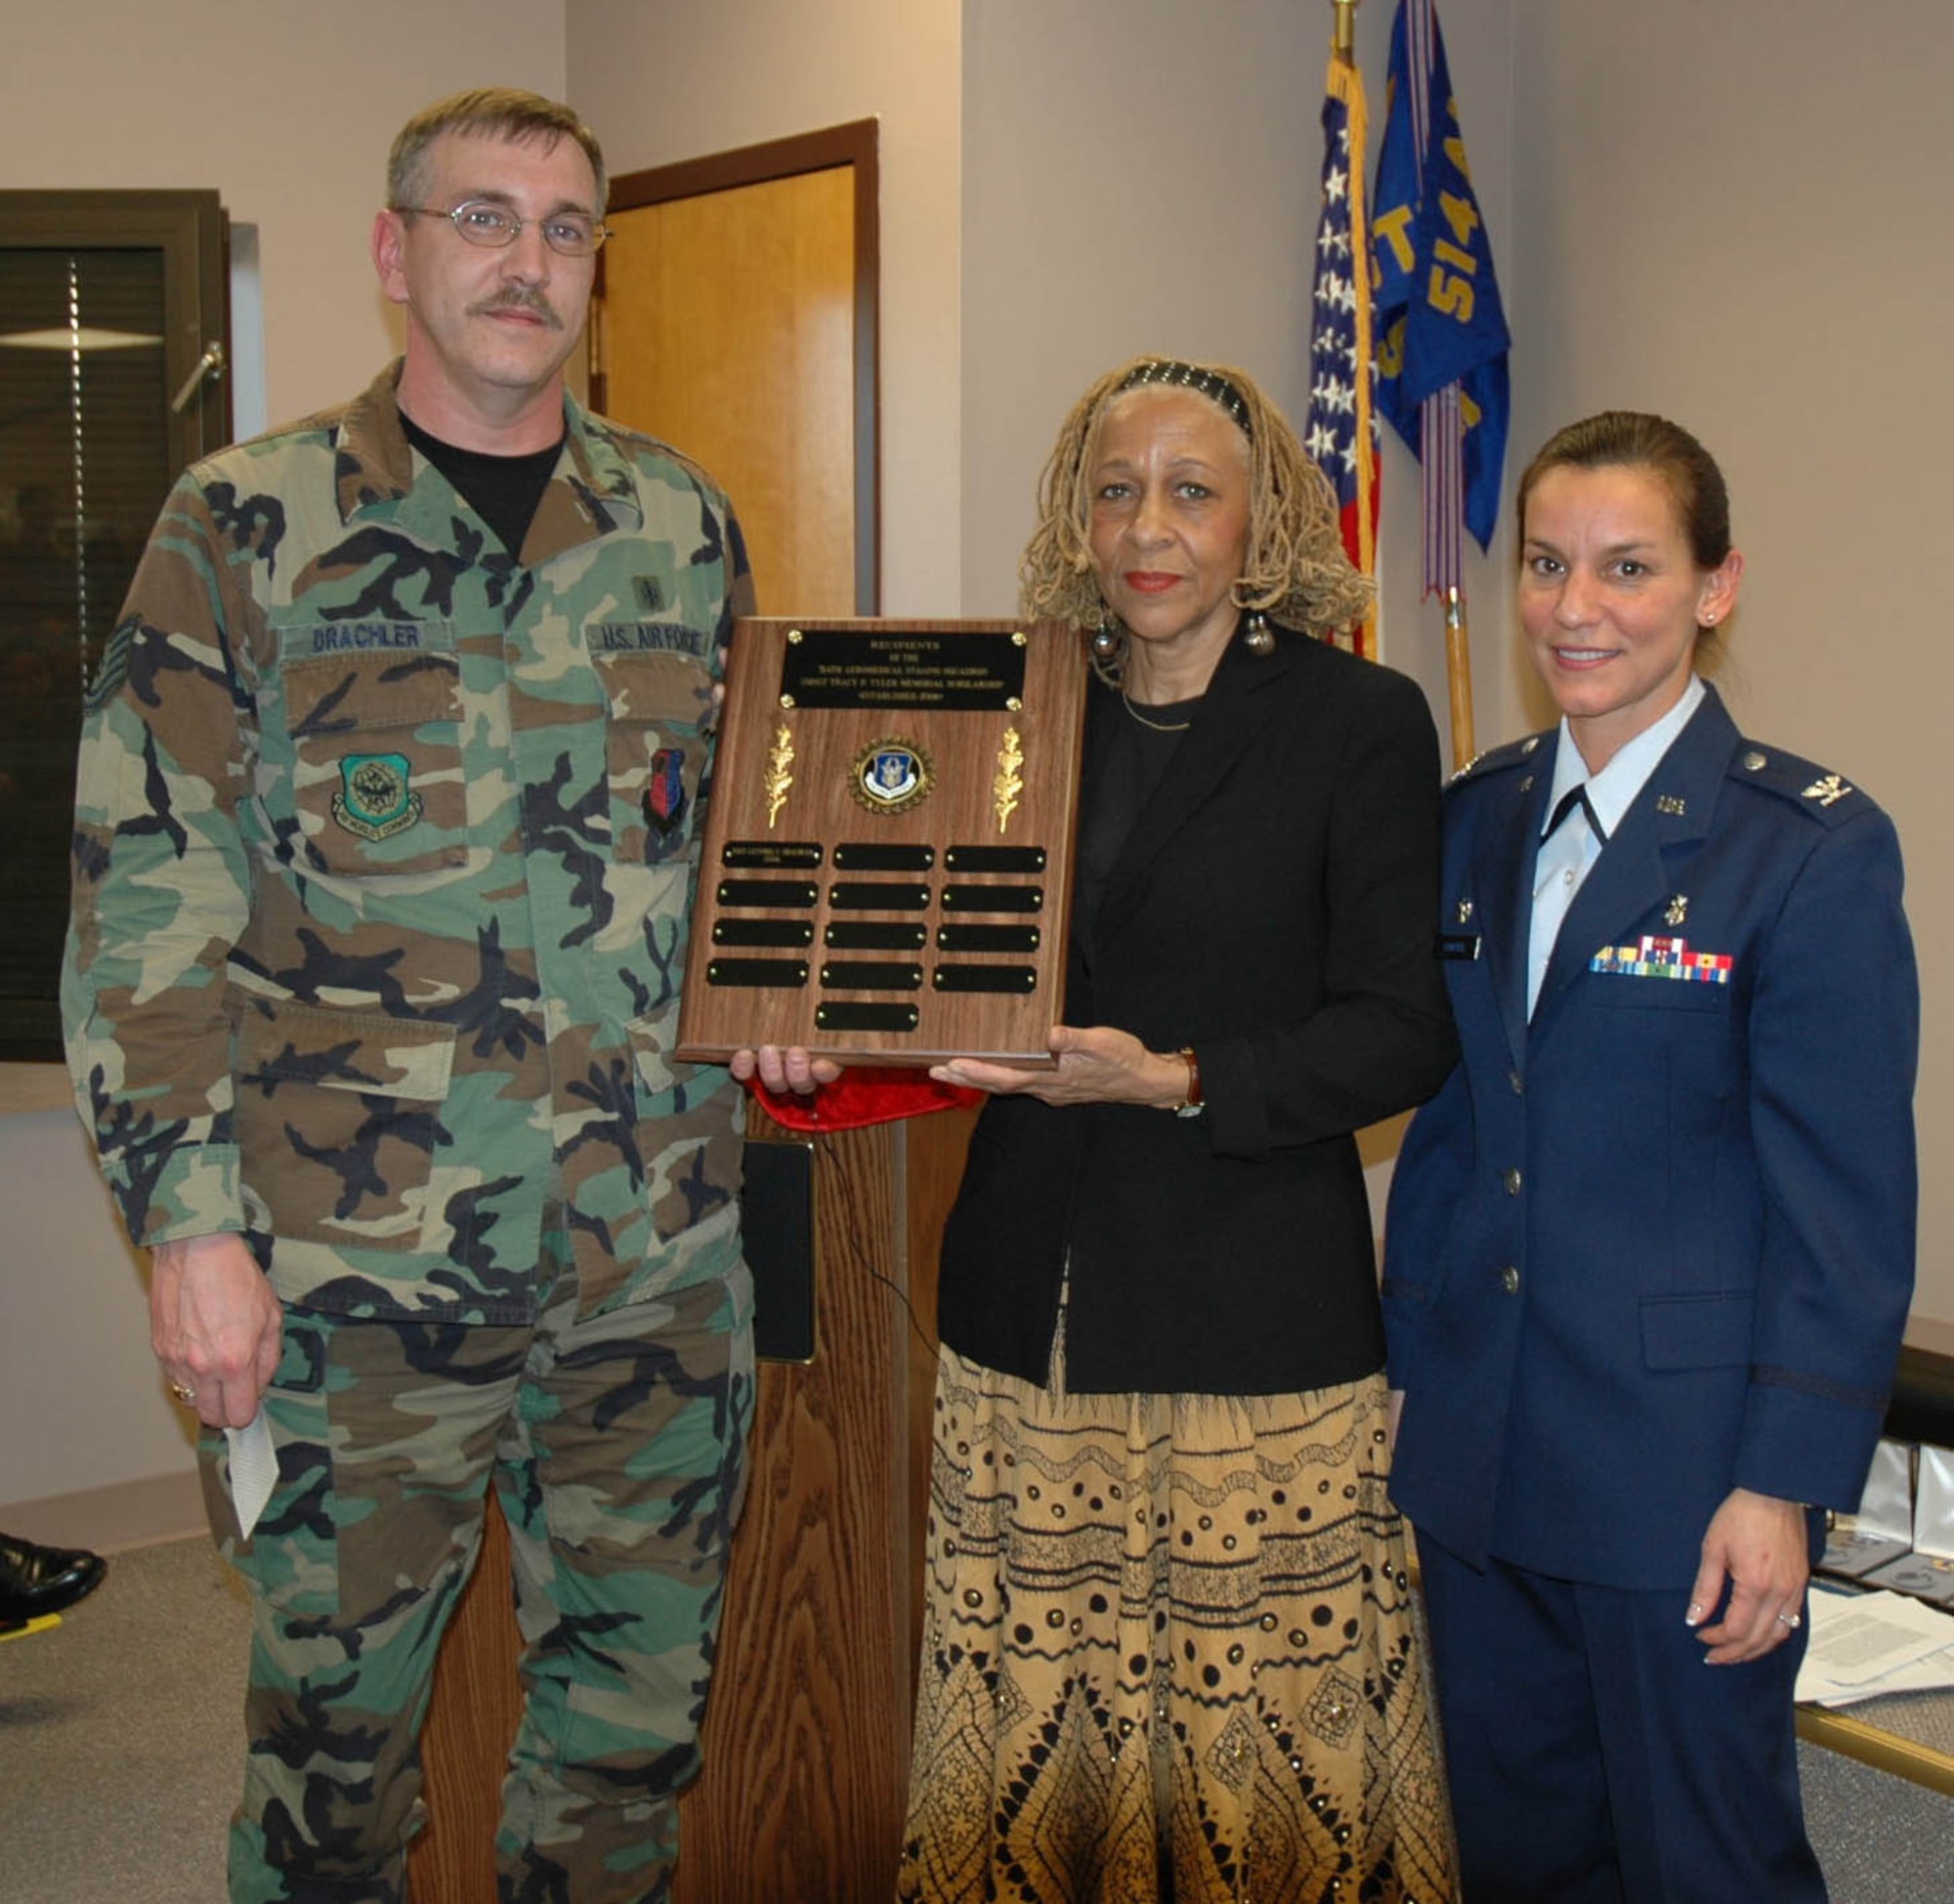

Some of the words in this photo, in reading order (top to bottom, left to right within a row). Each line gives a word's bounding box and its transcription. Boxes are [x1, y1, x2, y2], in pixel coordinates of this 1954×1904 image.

[312, 623, 419, 654] DRACHLER
[601, 622, 633, 650] U.S.
[637, 623, 663, 650] AIR
